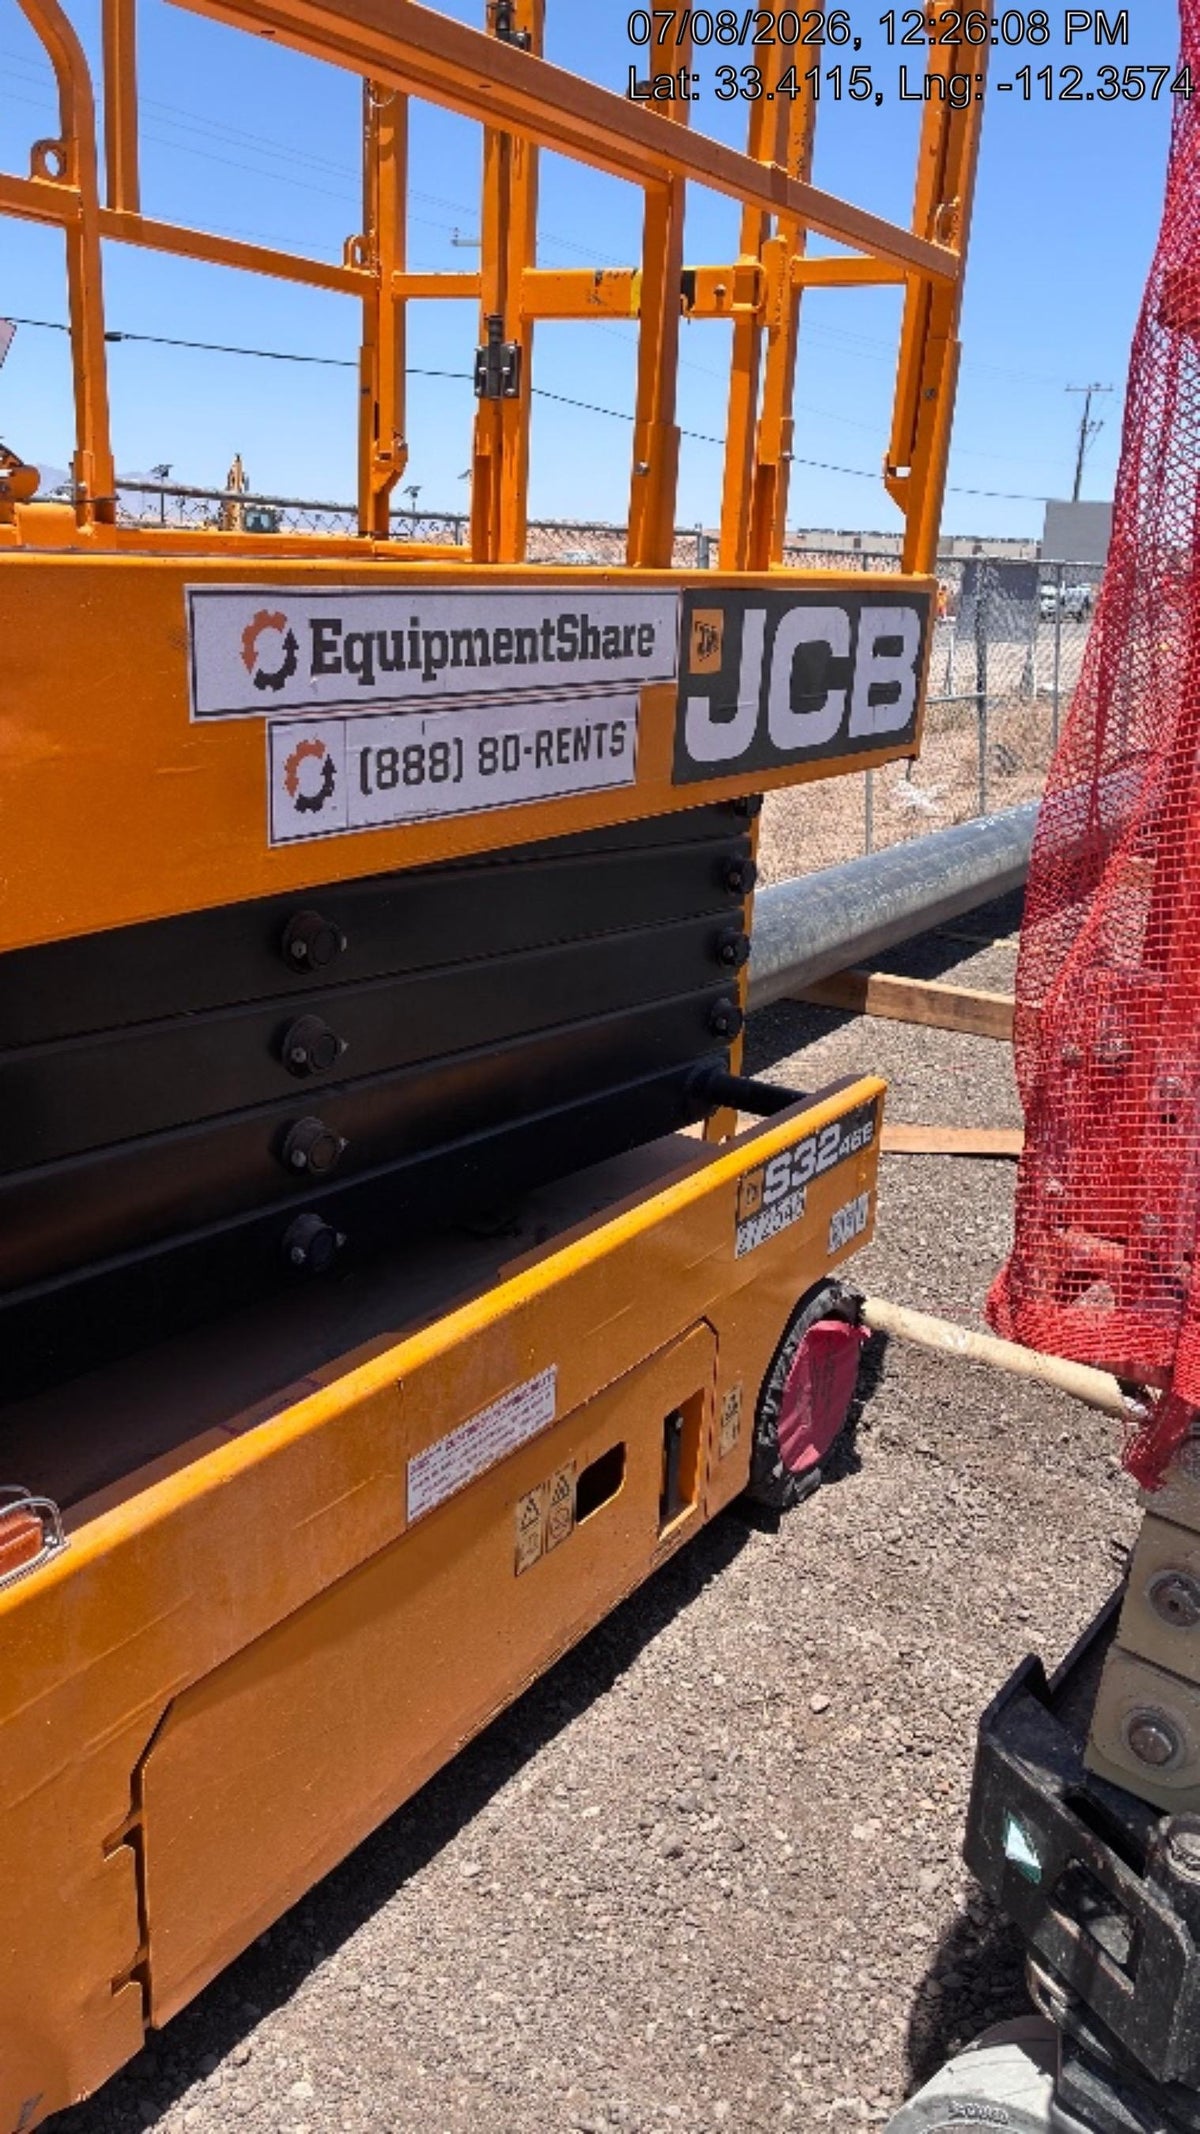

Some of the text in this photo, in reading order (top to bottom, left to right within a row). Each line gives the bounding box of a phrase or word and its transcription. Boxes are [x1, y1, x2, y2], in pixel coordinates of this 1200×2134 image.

[309, 613, 656, 686] EquipmentShare
[685, 606, 921, 762] JCB
[359, 720, 627, 796] (888) 80-RENTS
